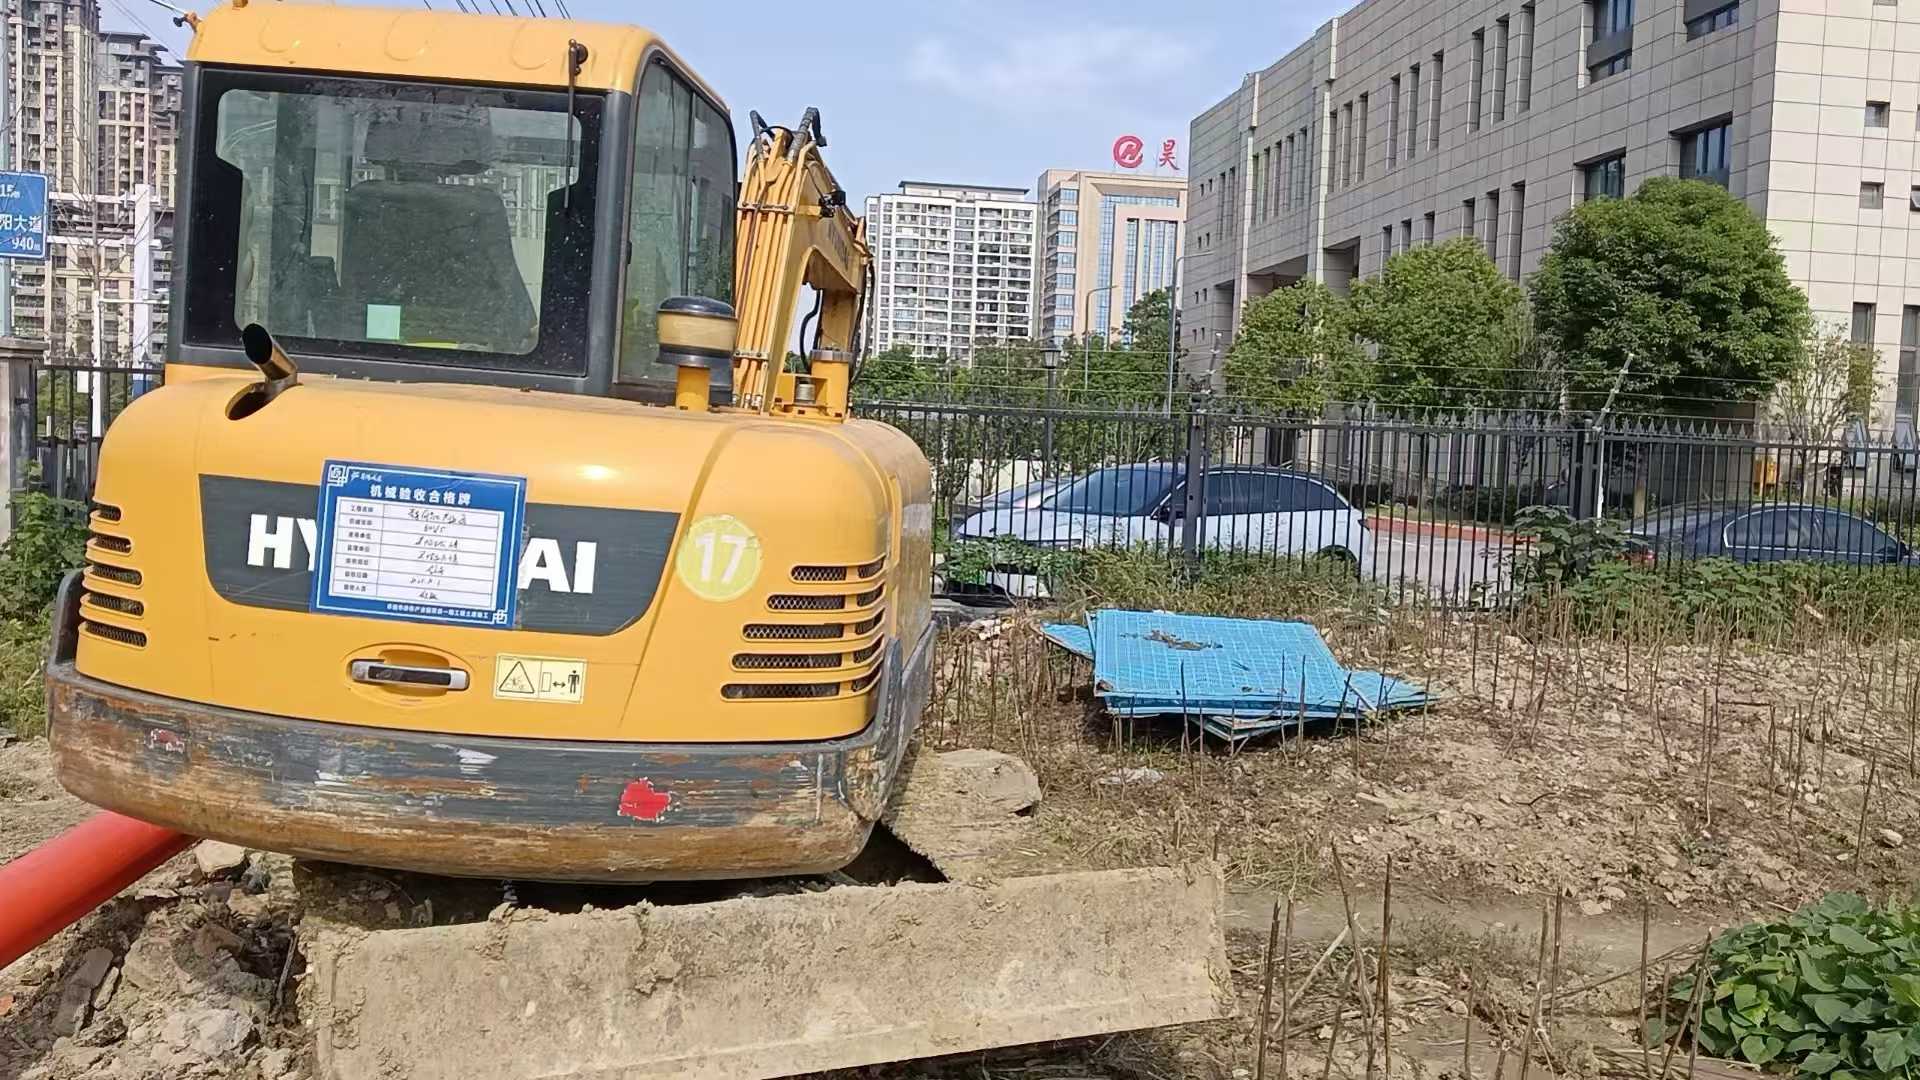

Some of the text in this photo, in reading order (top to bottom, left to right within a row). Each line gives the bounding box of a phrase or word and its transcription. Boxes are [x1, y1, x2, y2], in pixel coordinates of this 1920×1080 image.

[1159, 139, 1180, 170] 昊
[370, 484, 471, 506] 机械验收合格牌
[695, 531, 747, 585] 17
